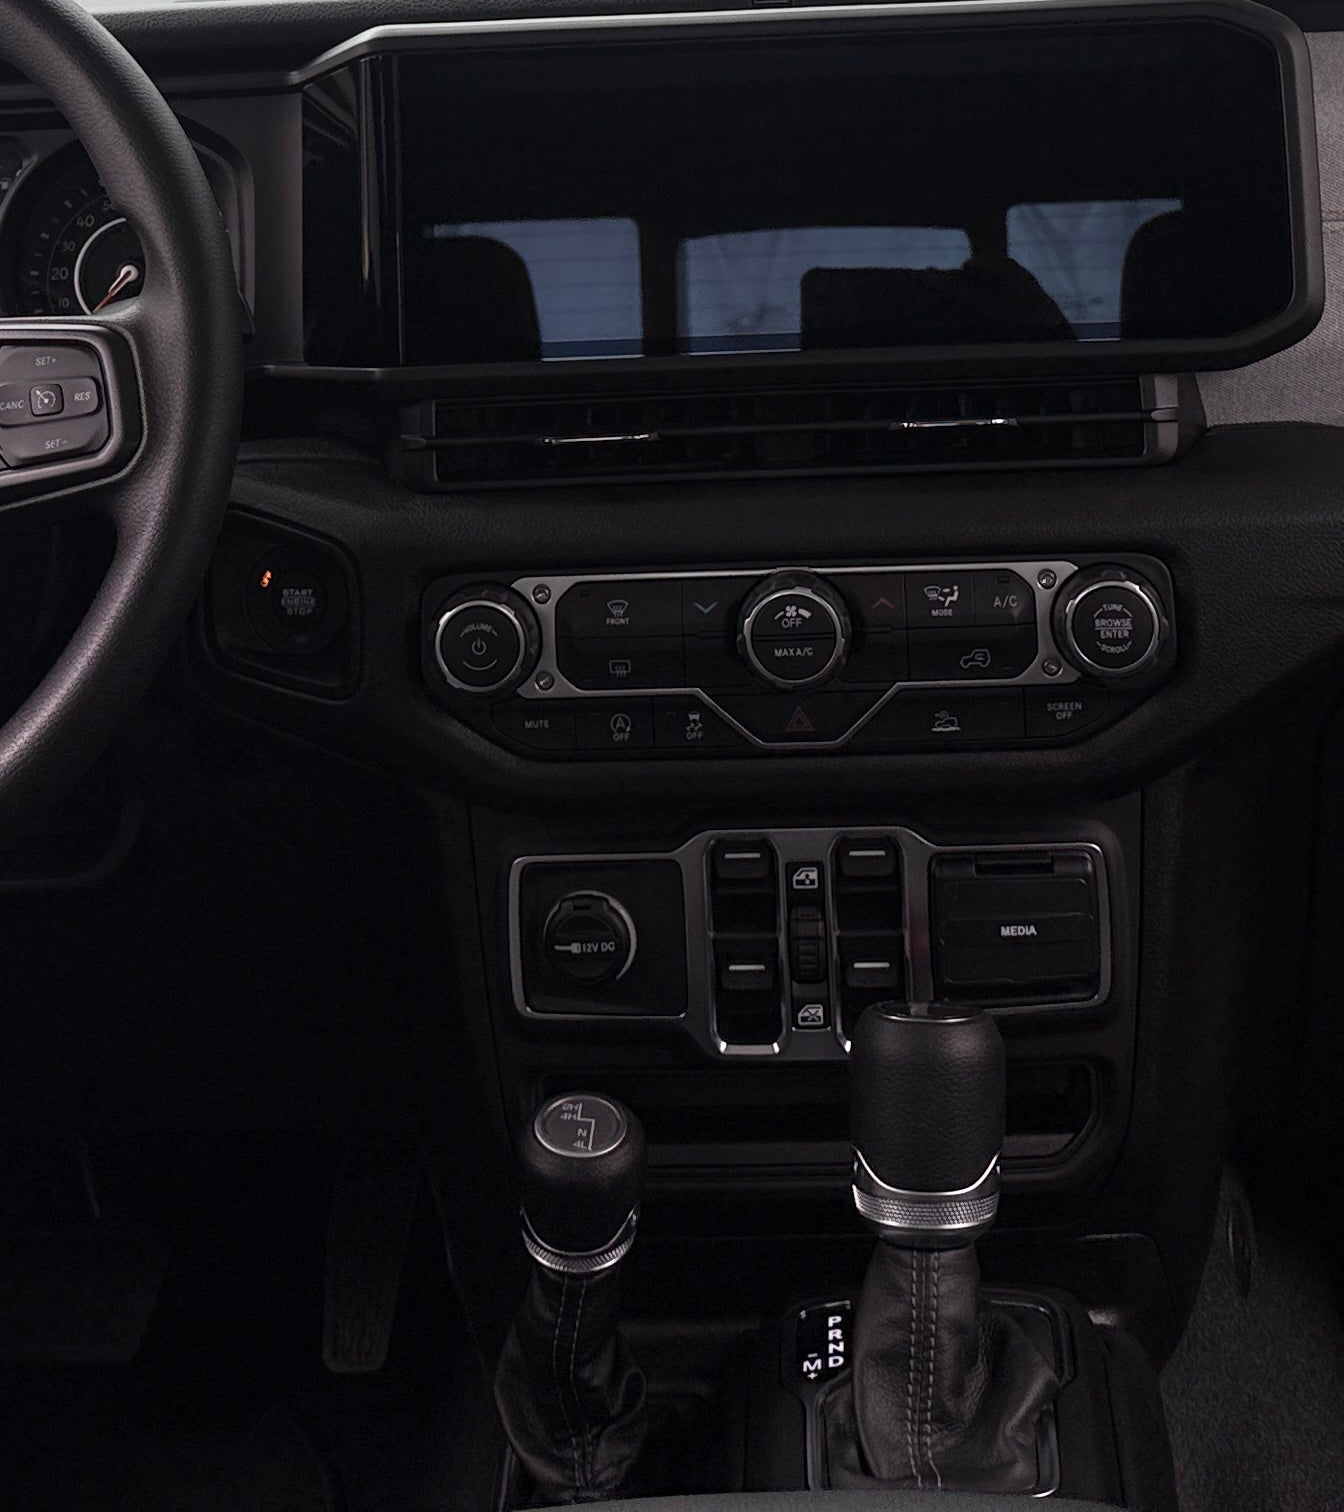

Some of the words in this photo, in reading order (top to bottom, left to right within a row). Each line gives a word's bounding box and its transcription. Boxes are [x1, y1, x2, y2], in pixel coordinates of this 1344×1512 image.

[76, 216, 96, 228] 40
[50, 267, 69, 281] 20
[73, 391, 91, 402] RES
[0, 399, 25, 411] CANC
[281, 588, 314, 597] START
[280, 597, 317, 607] ENGINE
[993, 595, 1018, 608] A/C
[286, 607, 313, 616] STOP
[931, 608, 953, 617] MODE
[1102, 603, 1124, 612] TUNE
[605, 616, 631, 626] FRONT
[781, 618, 803, 629] OFF
[1094, 617, 1133, 628] BROWSE
[463, 621, 495, 634] VOLUME
[1099, 629, 1130, 639] ENTER
[774, 648, 795, 658] MAX
[795, 646, 814, 656] A/C
[1099, 643, 1130, 654] SCROLL
[1046, 701, 1084, 712] SCREEN
[1055, 711, 1074, 720] OFF
[524, 718, 550, 729] MUTE
[612, 731, 631, 742] OFF
[685, 729, 704, 741] OFF
[1000, 924, 1038, 937] MEDIA
[582, 941, 599, 953] 12V
[600, 940, 616, 952] DC
[560, 1112, 577, 1121] 4H
[577, 1128, 588, 1137] N
[572, 1140, 587, 1149] 4L
[827, 1315, 843, 1328] P
[827, 1328, 844, 1341] R
[828, 1341, 845, 1355] N
[802, 1358, 823, 1373] M
[828, 1355, 845, 1368] D
